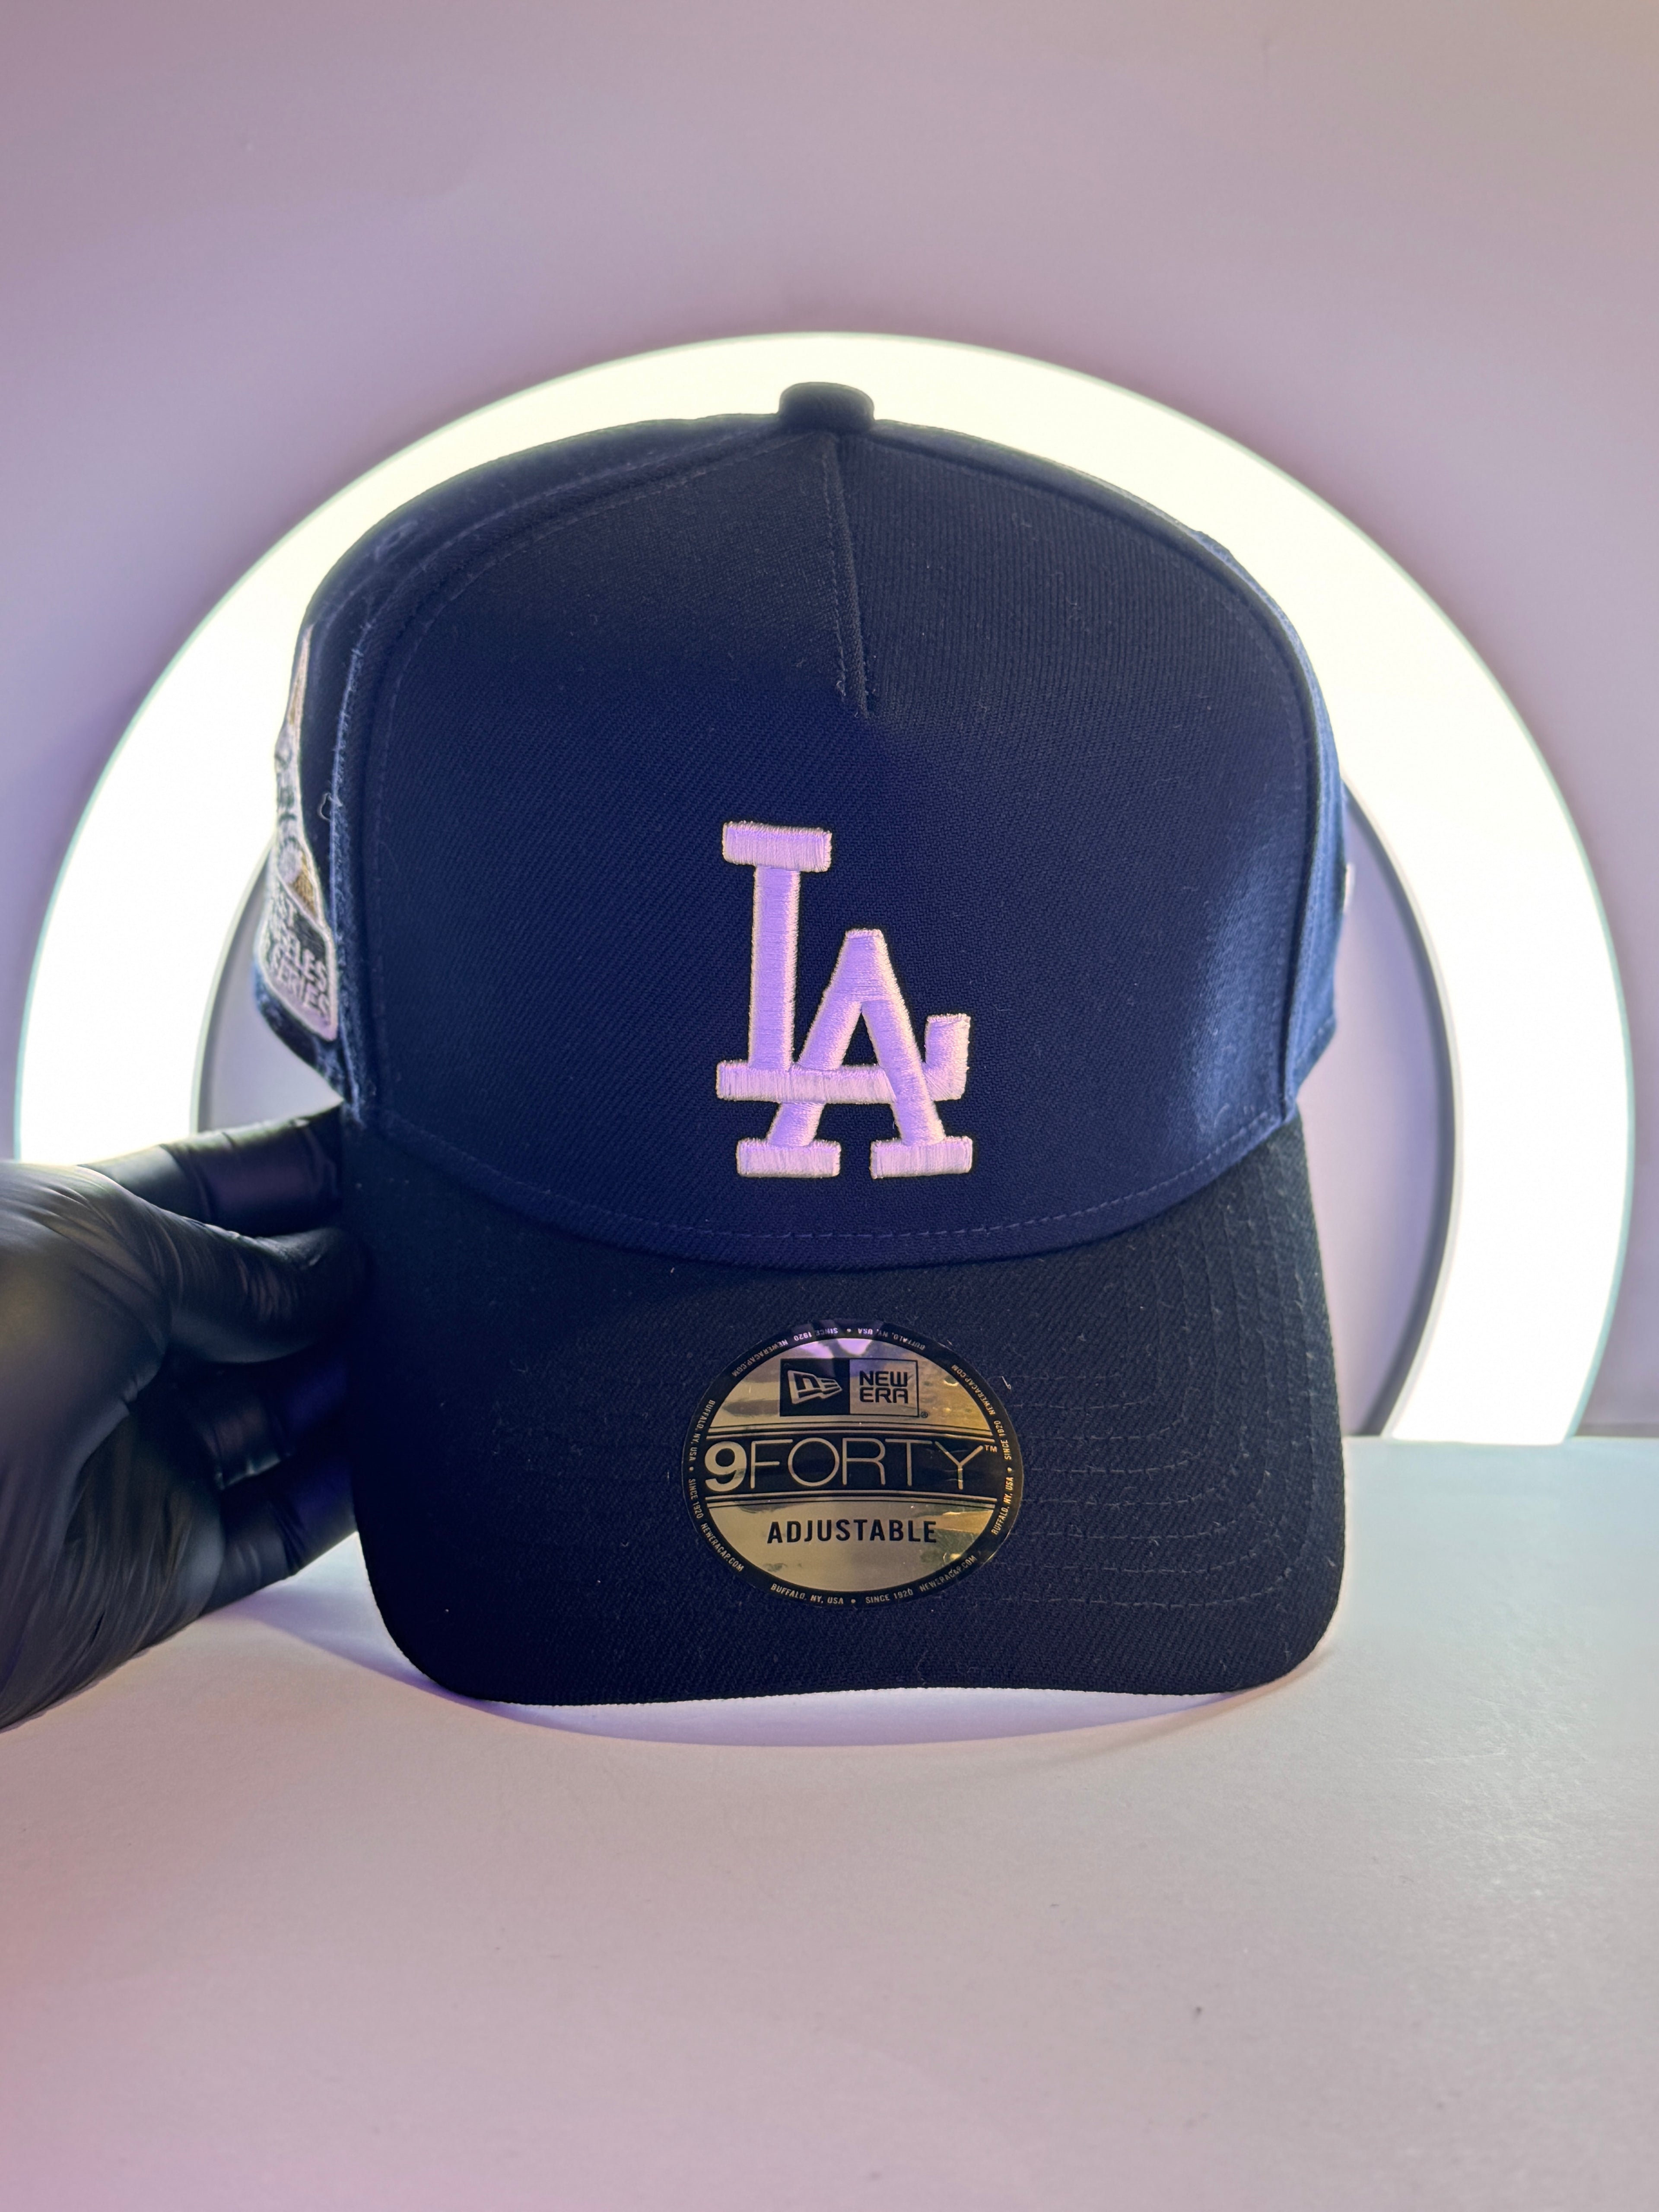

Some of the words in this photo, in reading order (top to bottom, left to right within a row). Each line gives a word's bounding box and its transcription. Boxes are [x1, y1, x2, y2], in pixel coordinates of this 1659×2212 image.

[716, 821, 973, 1179] LA
[793, 1331, 812, 1341] 1920
[815, 1327, 839, 1336] SINCE
[859, 1370, 908, 1387] NEW
[859, 1387, 909, 1404] ERA
[993, 1420, 1007, 1437] 1920
[688, 1447, 698, 1461] USA
[1000, 1439, 1012, 1461] SINCE
[688, 1478, 699, 1500] SINCE
[1005, 1477, 1014, 1491] USA
[692, 1501, 704, 1519] 1920
[767, 1519, 937, 1545] ADJUSTABLE
[701, 1522, 744, 1572] NEWERACAP.COM
[827, 1596, 844, 1605] USA
[865, 1593, 890, 1604] SINCE
[893, 1588, 914, 1600] 1920
